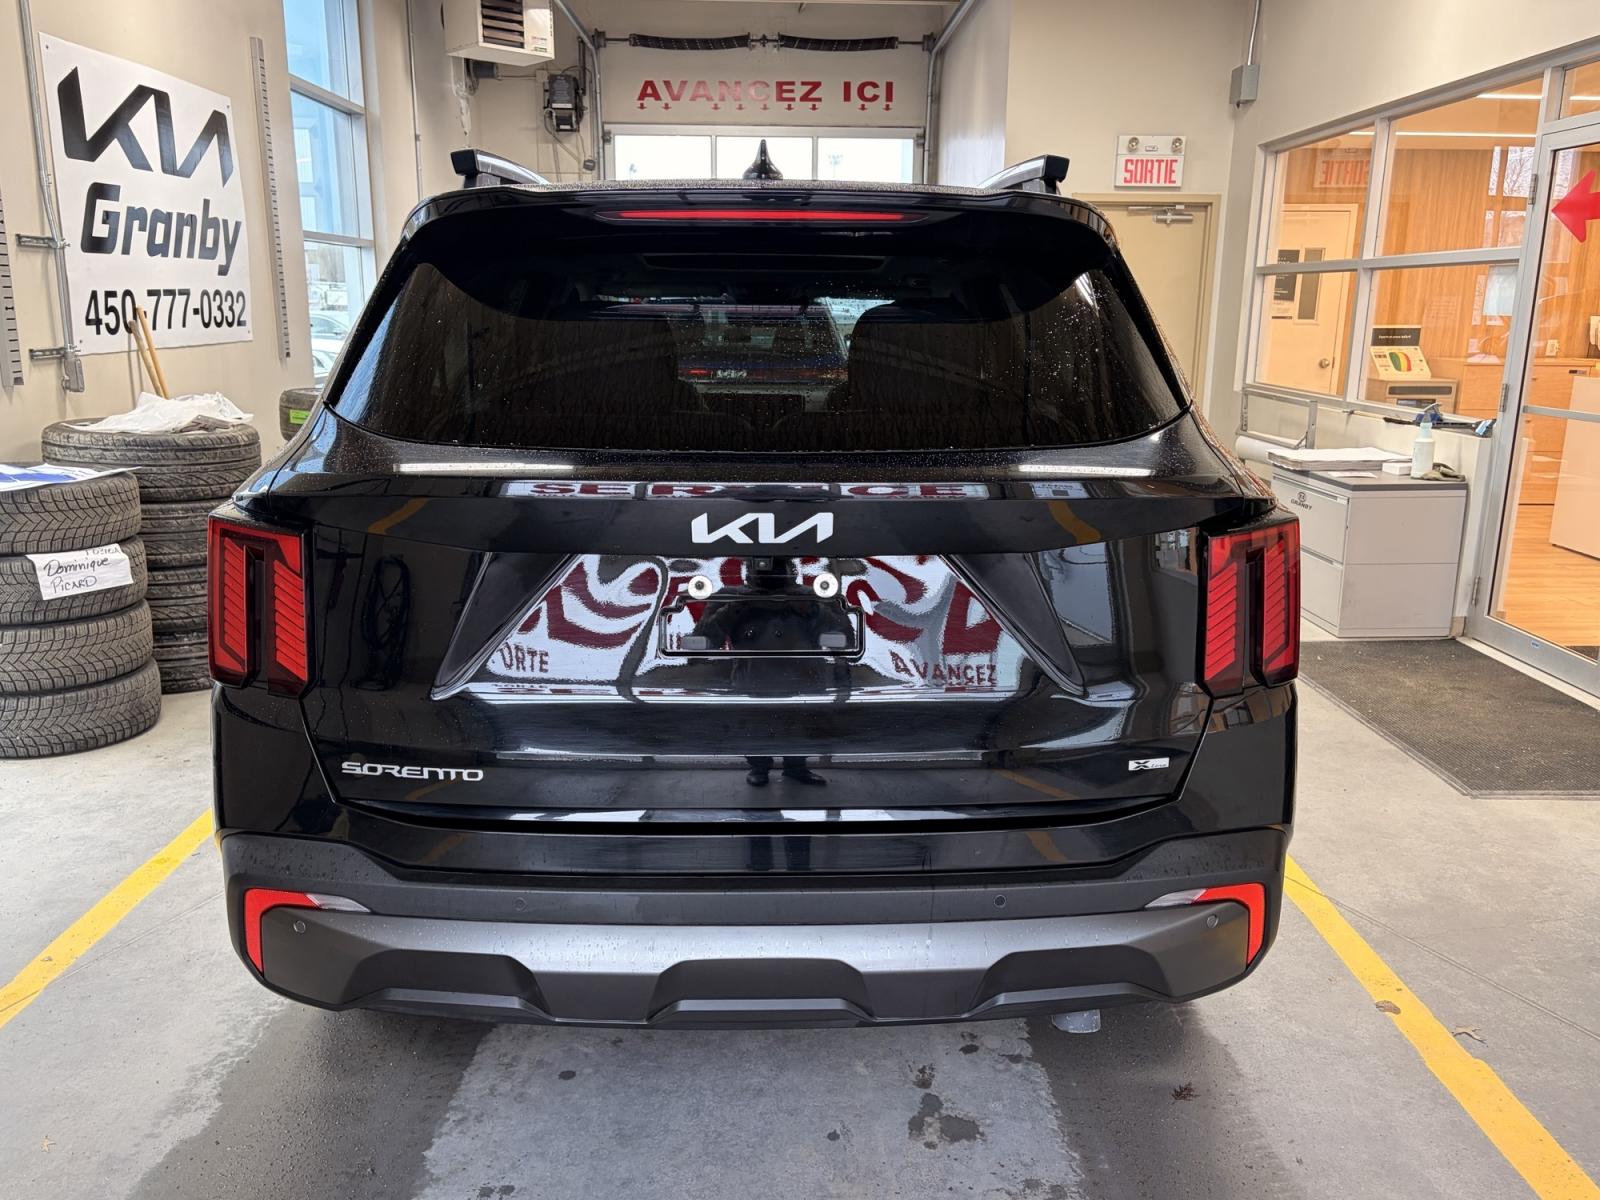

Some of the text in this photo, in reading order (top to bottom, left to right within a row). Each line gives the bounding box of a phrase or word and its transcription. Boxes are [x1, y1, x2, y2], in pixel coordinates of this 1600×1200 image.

[636, 80, 894, 103] AVANCEZ ICI
[57, 66, 234, 188] KIA
[1124, 159, 1178, 184] SORTIE
[80, 181, 242, 277] Granby
[531, 483, 967, 499] SERCE
[691, 512, 834, 543] KIA
[43, 557, 110, 577] Dominique
[341, 761, 484, 782] SORENTO
